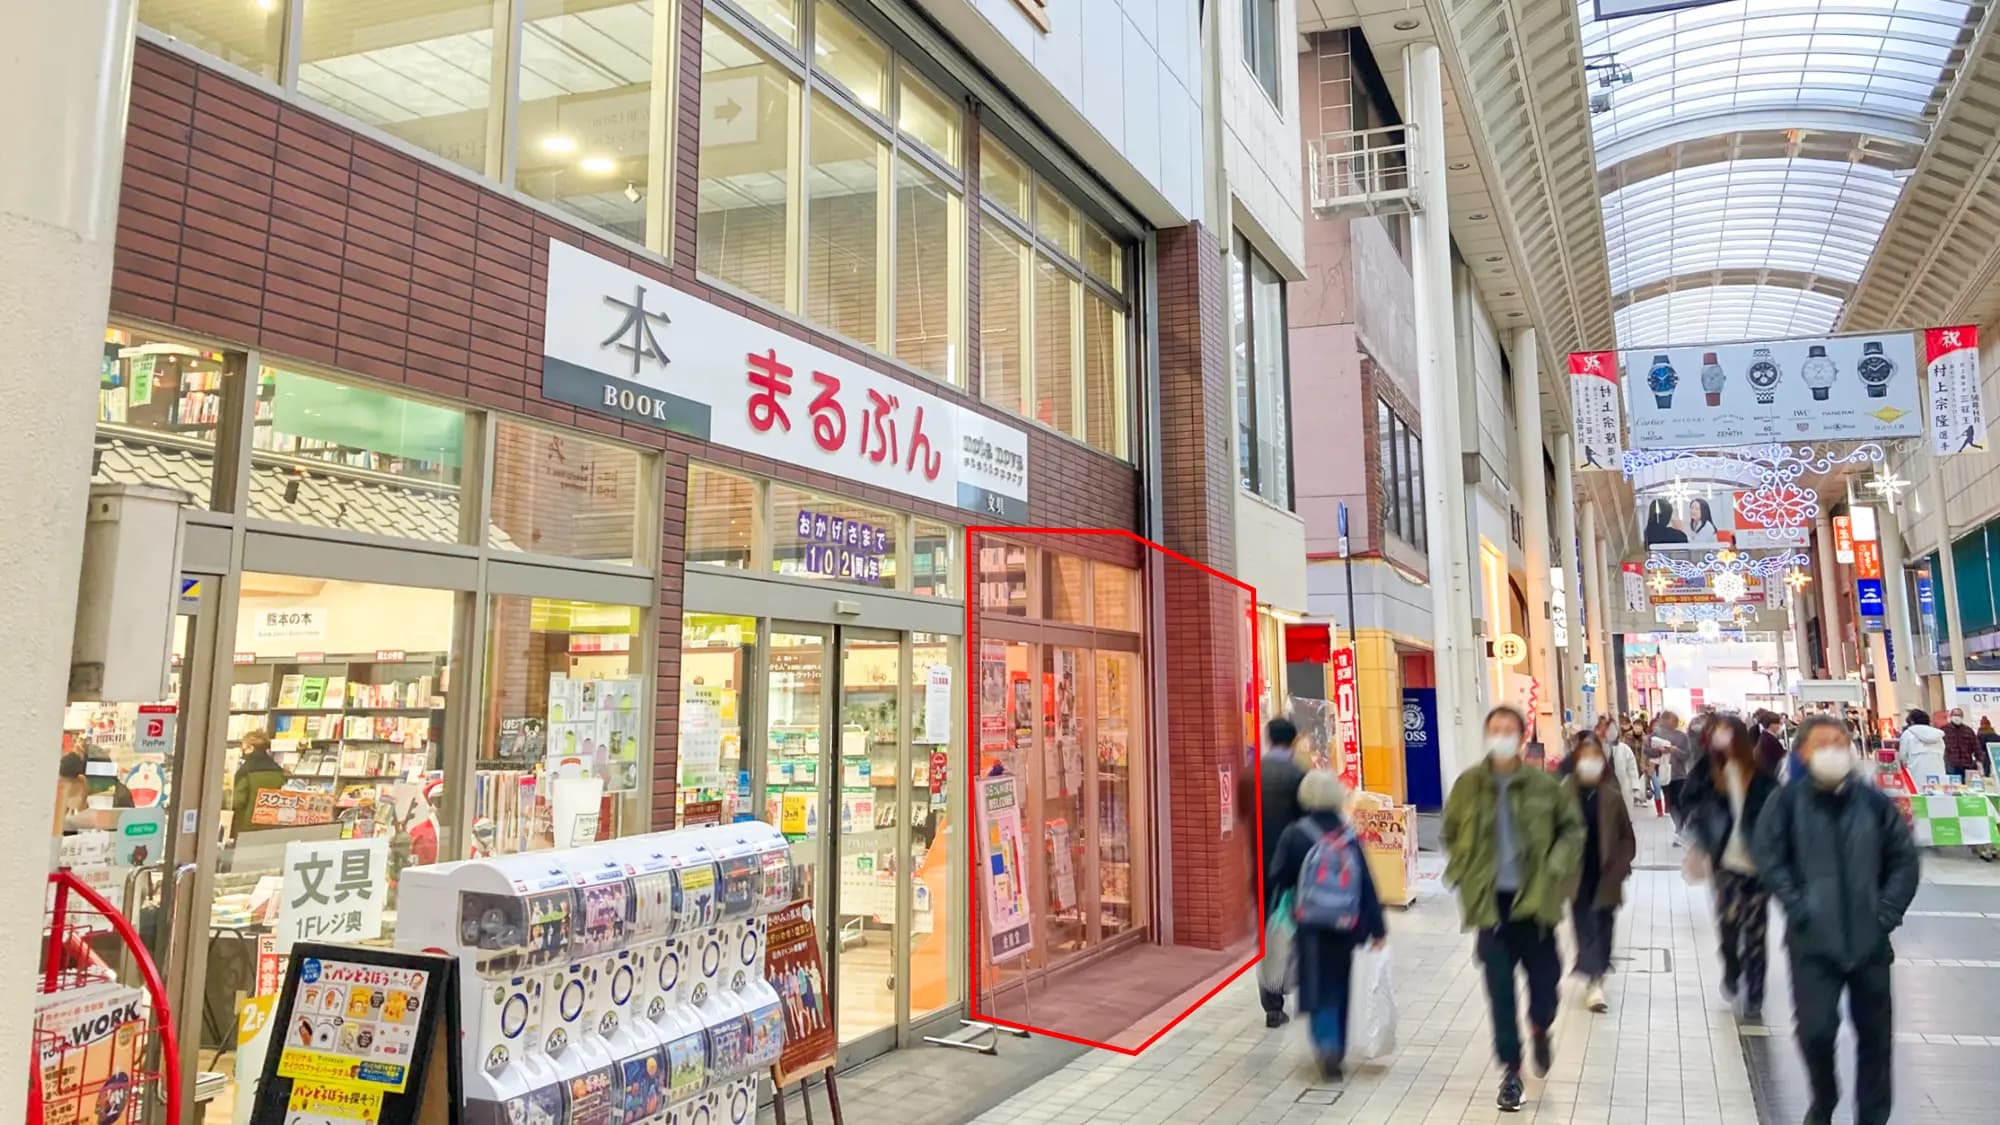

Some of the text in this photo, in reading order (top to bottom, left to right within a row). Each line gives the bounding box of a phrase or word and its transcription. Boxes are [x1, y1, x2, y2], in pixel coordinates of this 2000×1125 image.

[601, 284, 671, 375] 本
[1942, 330, 1962, 347] 祝
[603, 384, 667, 421] BOOK
[747, 348, 942, 481] まるぶん
[799, 514, 886, 550] おかげさまで
[810, 546, 879, 580] 102周年
[267, 611, 313, 627] 熊本の本
[142, 738, 165, 748] PayPay
[1404, 730, 1427, 742] OSS
[291, 848, 373, 909] 文具
[296, 910, 362, 939] 1Fレジ奥
[71, 999, 140, 1046] WORK
[241, 1003, 265, 1032] 2F
